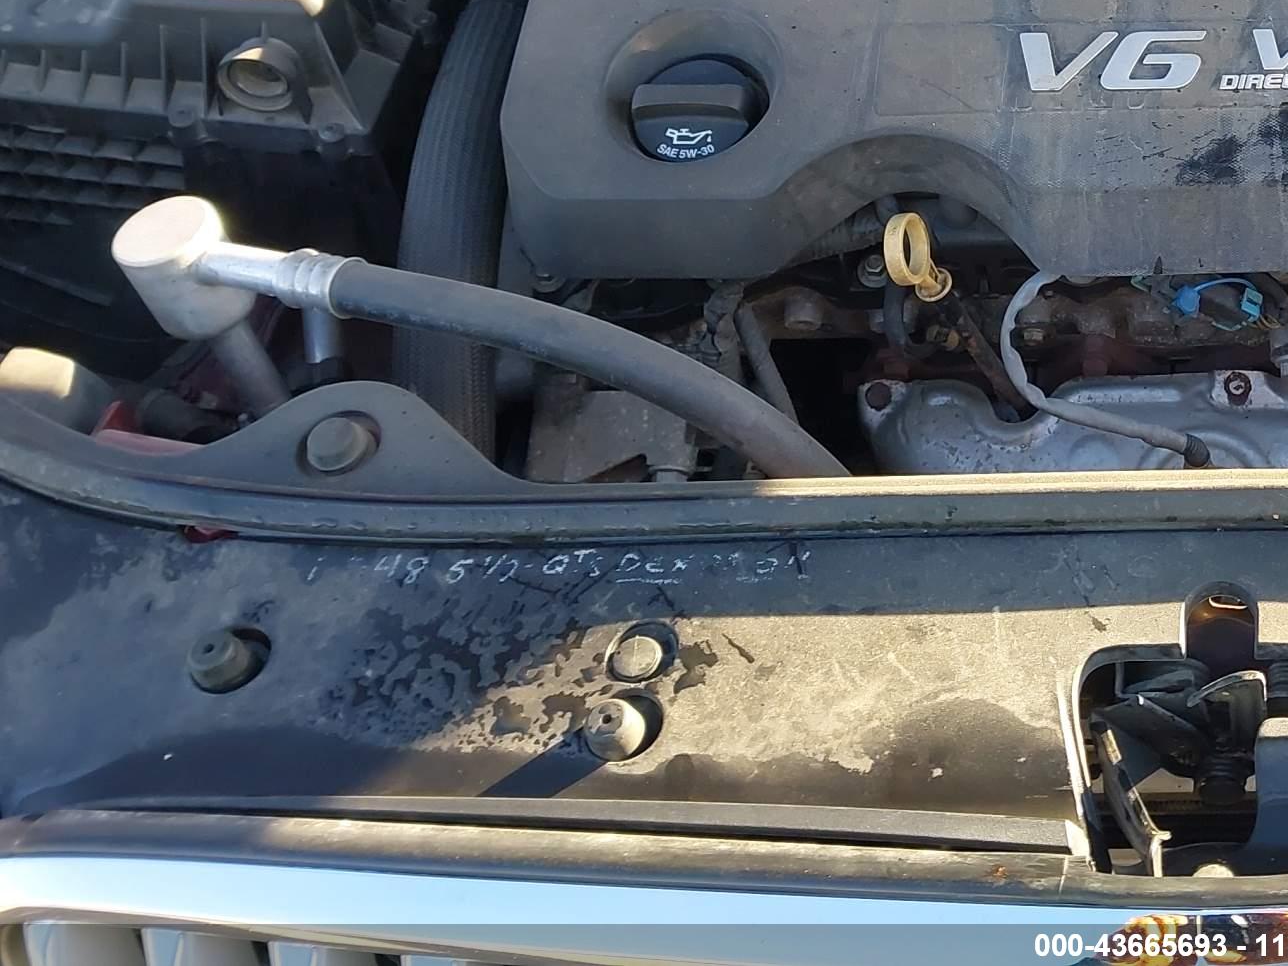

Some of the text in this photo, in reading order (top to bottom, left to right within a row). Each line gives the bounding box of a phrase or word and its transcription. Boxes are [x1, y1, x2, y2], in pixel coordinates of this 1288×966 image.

[1019, 30, 1207, 91] V6
[657, 143, 715, 159] SAE 5W-30
